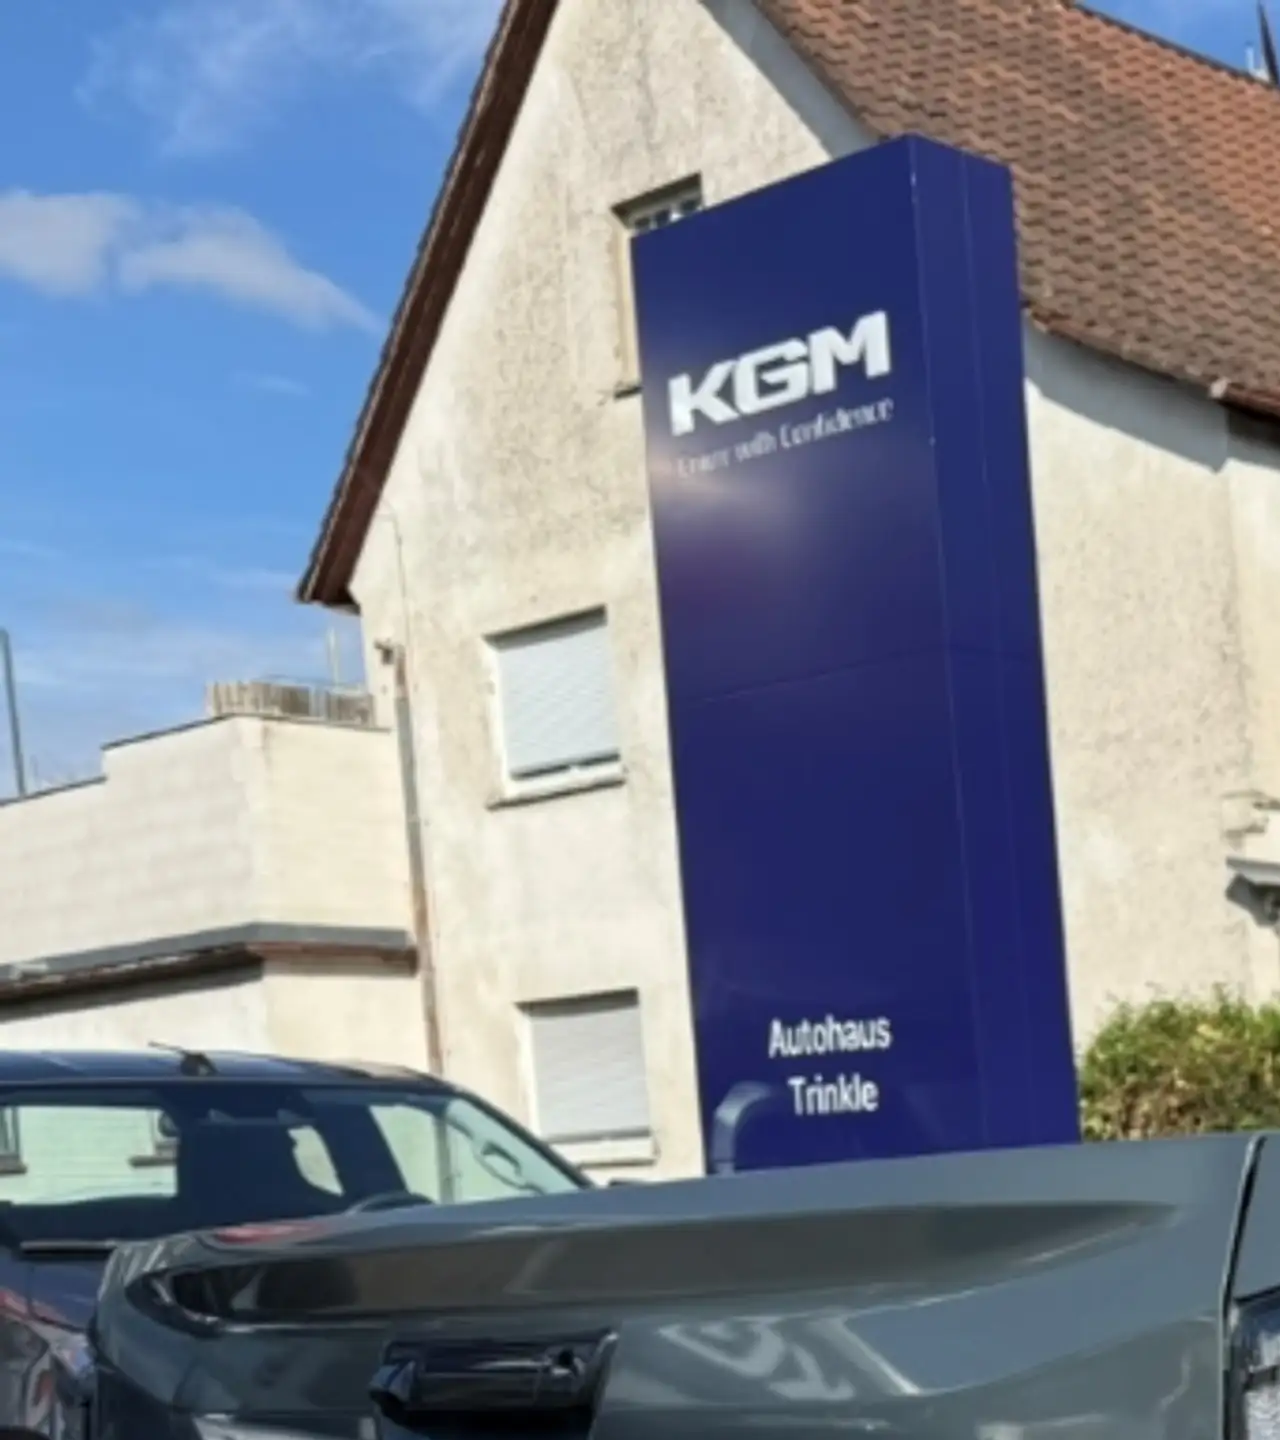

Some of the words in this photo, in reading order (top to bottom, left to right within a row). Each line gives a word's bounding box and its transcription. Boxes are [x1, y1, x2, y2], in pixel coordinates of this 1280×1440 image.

[667, 309, 892, 437] KGM
[768, 1013, 894, 1059] Autohaus
[787, 1072, 880, 1116] Trinkle
